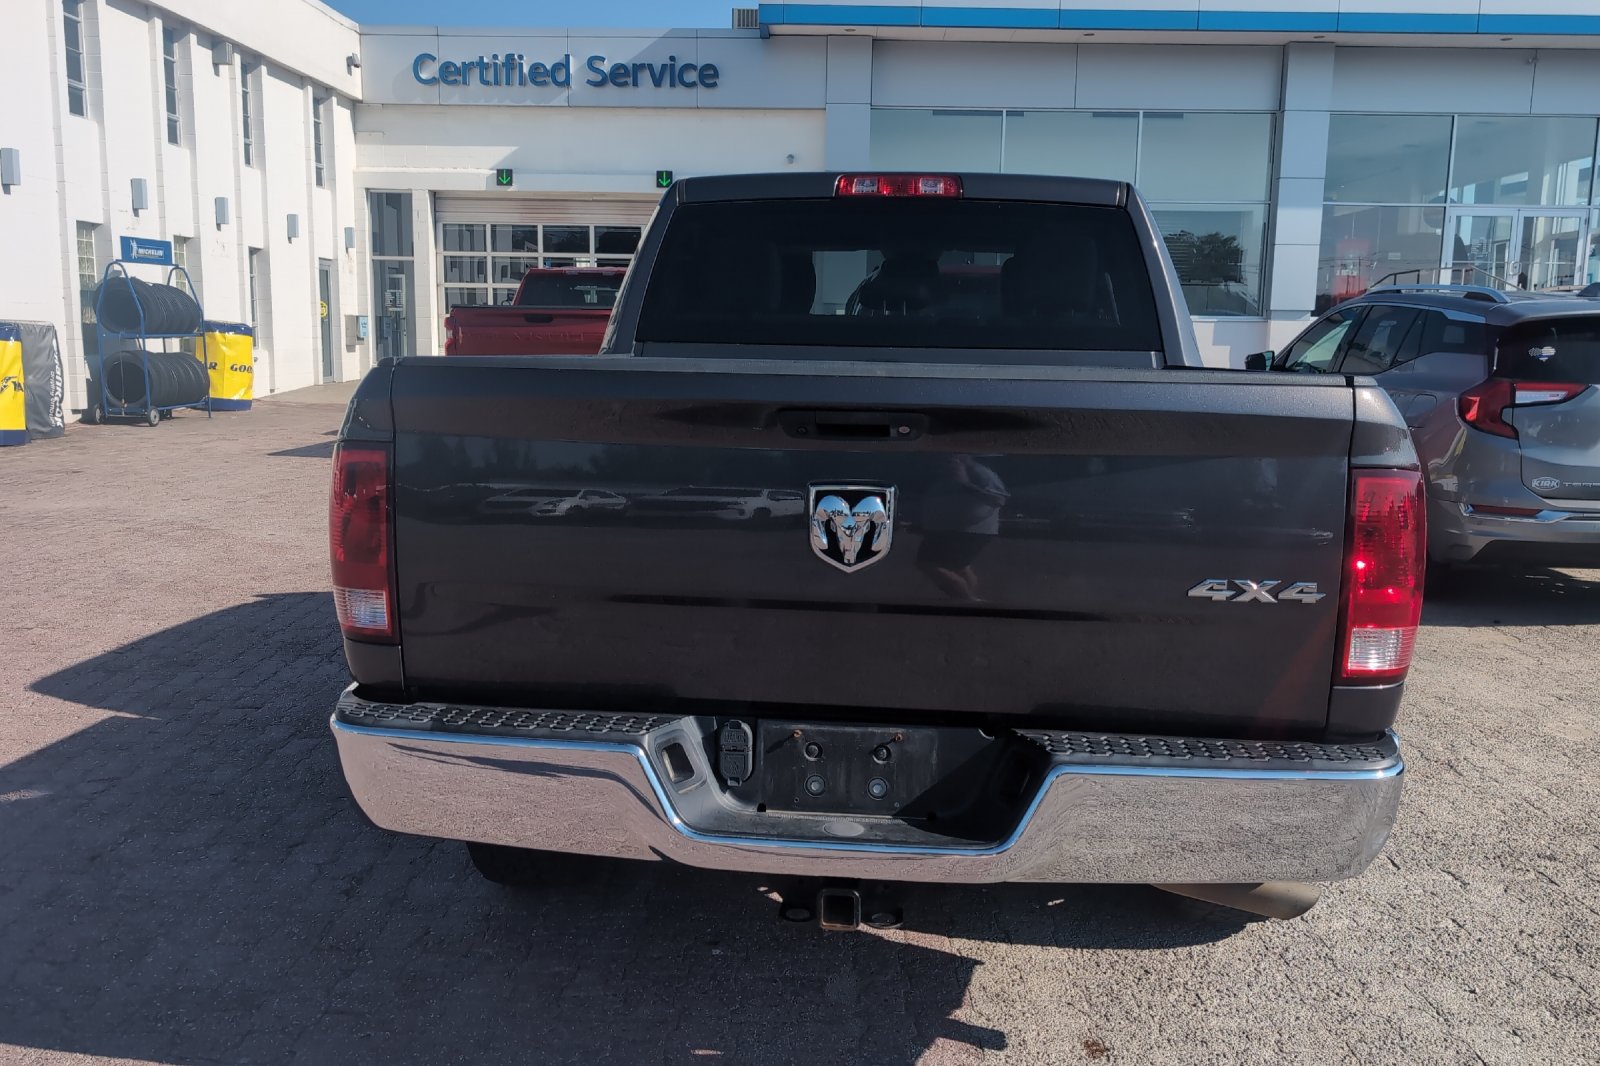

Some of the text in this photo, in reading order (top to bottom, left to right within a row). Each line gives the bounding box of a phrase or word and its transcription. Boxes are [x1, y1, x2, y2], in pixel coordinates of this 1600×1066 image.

[412, 52, 720, 89] Certified Service
[137, 247, 164, 257] MICHELIN
[1187, 578, 1327, 604] 4X4
